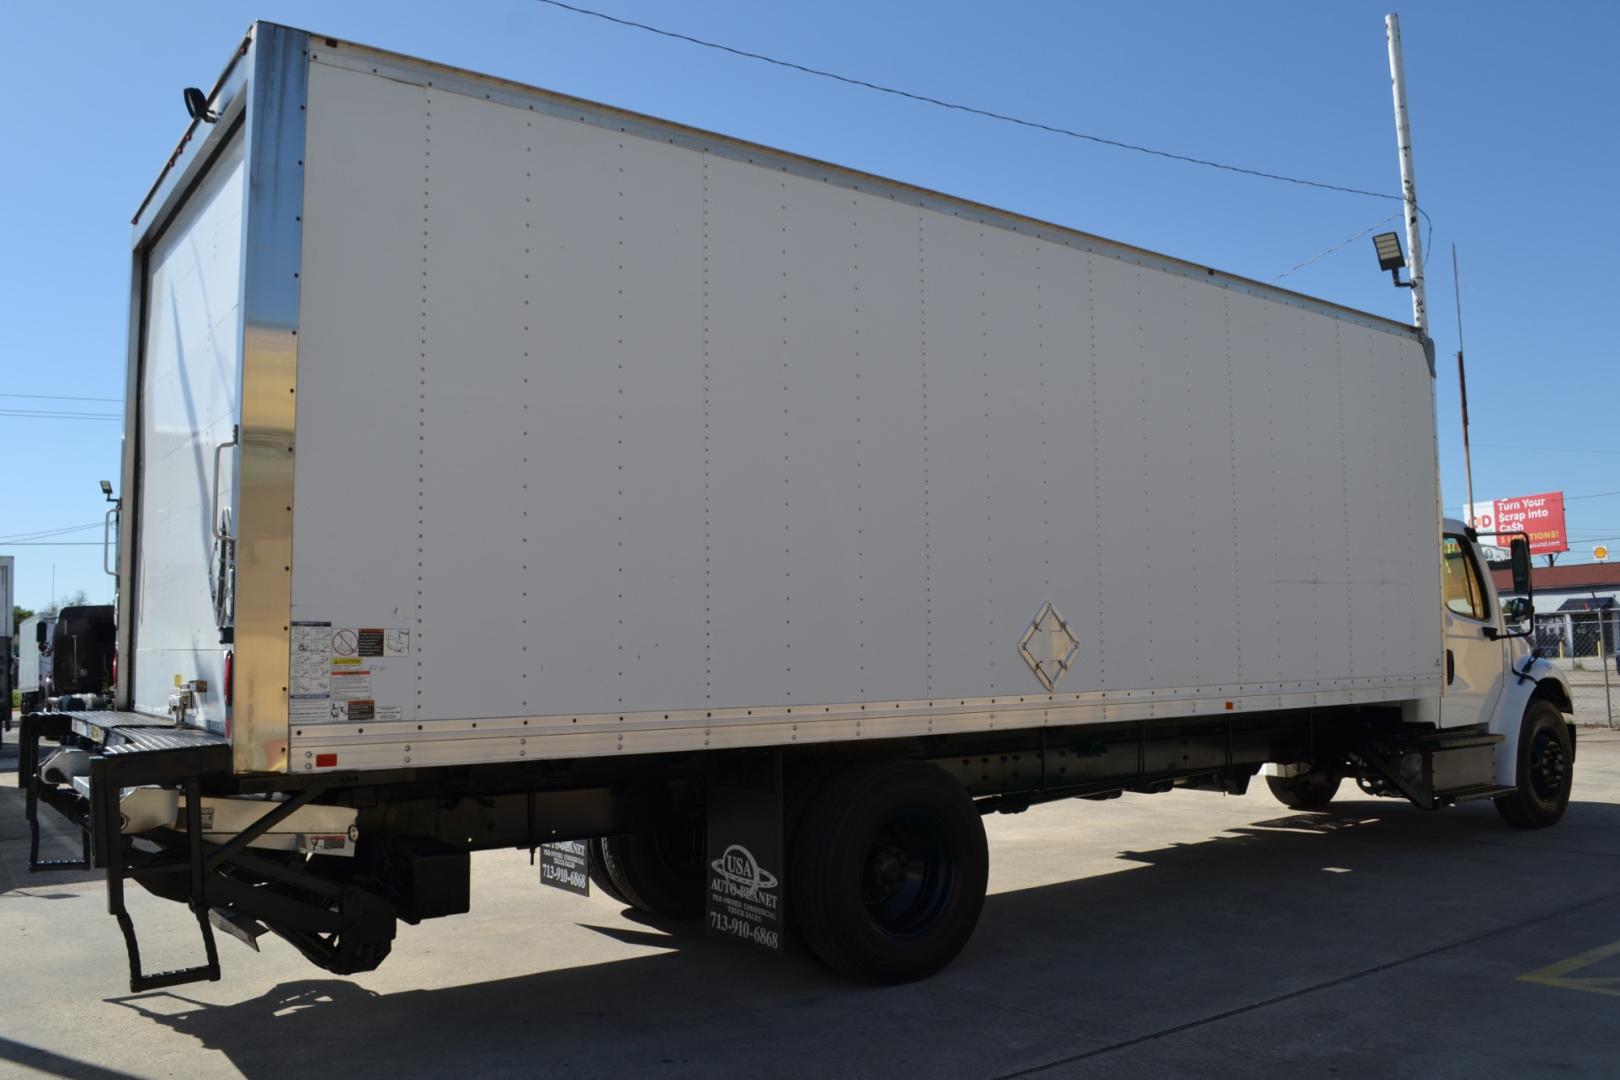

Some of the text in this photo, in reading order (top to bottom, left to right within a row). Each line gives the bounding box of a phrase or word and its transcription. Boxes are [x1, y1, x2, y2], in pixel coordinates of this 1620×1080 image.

[1498, 498, 1546, 511] Turn Your
[1499, 509, 1549, 523] $crap into
[543, 863, 586, 888] 713-910-6868
[727, 855, 752, 877] USA
[710, 911, 779, 950] 713-910-6868
